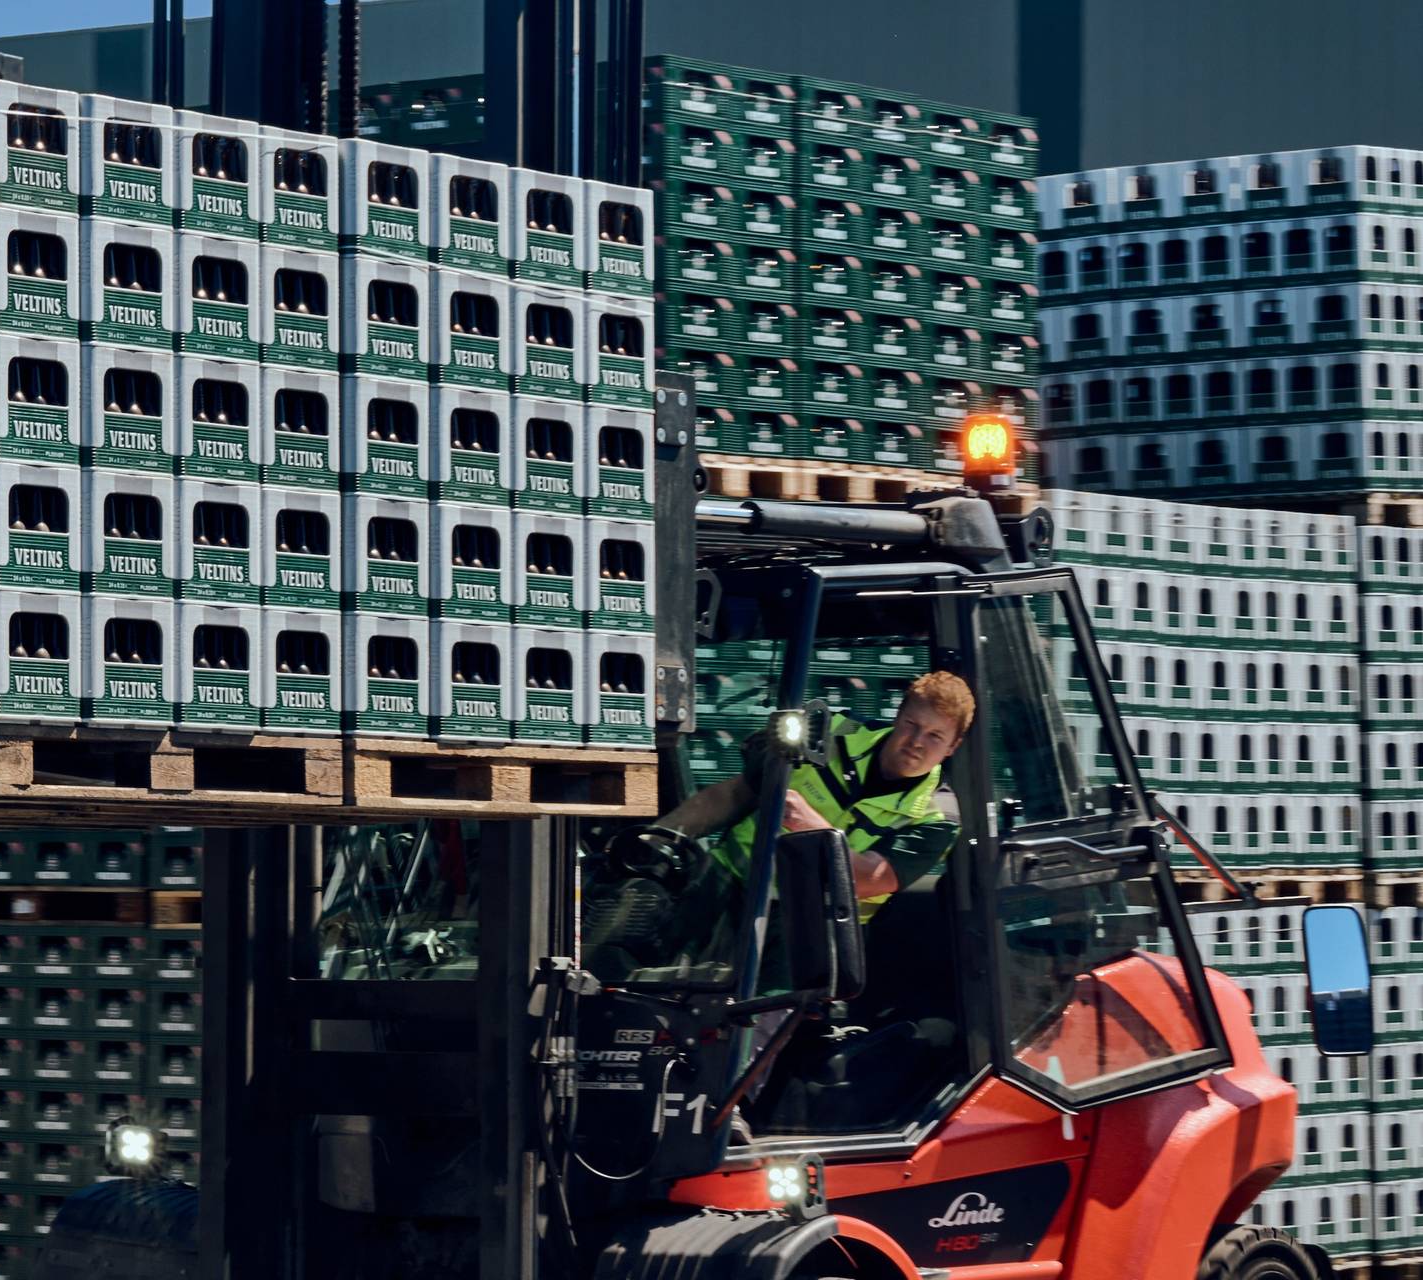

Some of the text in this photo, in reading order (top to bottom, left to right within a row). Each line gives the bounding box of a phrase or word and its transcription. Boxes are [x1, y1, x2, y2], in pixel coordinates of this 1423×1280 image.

[13, 166, 61, 189] VELTINS
[109, 180, 156, 202] VELTINS
[197, 194, 242, 216] VELTINS
[279, 208, 323, 229] VELTINS
[372, 221, 414, 241] VELTINS
[454, 234, 494, 254] VELTINS
[530, 246, 570, 266] VELTINS
[14, 293, 62, 316] VELTINS
[109, 305, 156, 327] VELTINS
[197, 317, 242, 339] VELTINS
[279, 328, 324, 349] VELTINS
[372, 339, 413, 359] VELTINS
[454, 350, 494, 369] VELTINS
[530, 361, 570, 380] VELTINS
[14, 420, 62, 442] VELTINS
[109, 430, 156, 451] VELTINS
[197, 440, 242, 461] VELTINS
[280, 449, 324, 469] VELTINS
[372, 458, 413, 477] VELTINS
[454, 467, 495, 485] VELTINS
[530, 475, 570, 494] VELTINS
[14, 548, 62, 568] VELTINS
[109, 555, 156, 575] VELTINS
[197, 563, 243, 583] VELTINS
[280, 570, 324, 589] VELTINS
[372, 576, 413, 594] VELTINS
[455, 583, 496, 601] VELTINS
[529, 590, 569, 608] VELTINS
[15, 675, 63, 695] VELTINS
[109, 680, 156, 700] VELTINS
[198, 686, 243, 705] VELTINS
[280, 690, 325, 709] VELTINS
[372, 695, 413, 712] VELTINS
[455, 700, 496, 717] VELTINS
[529, 704, 569, 722] VELTINS
[617, 1032, 651, 1042] RFS
[652, 1093, 708, 1134] F1
[928, 1192, 1004, 1228] Linde
